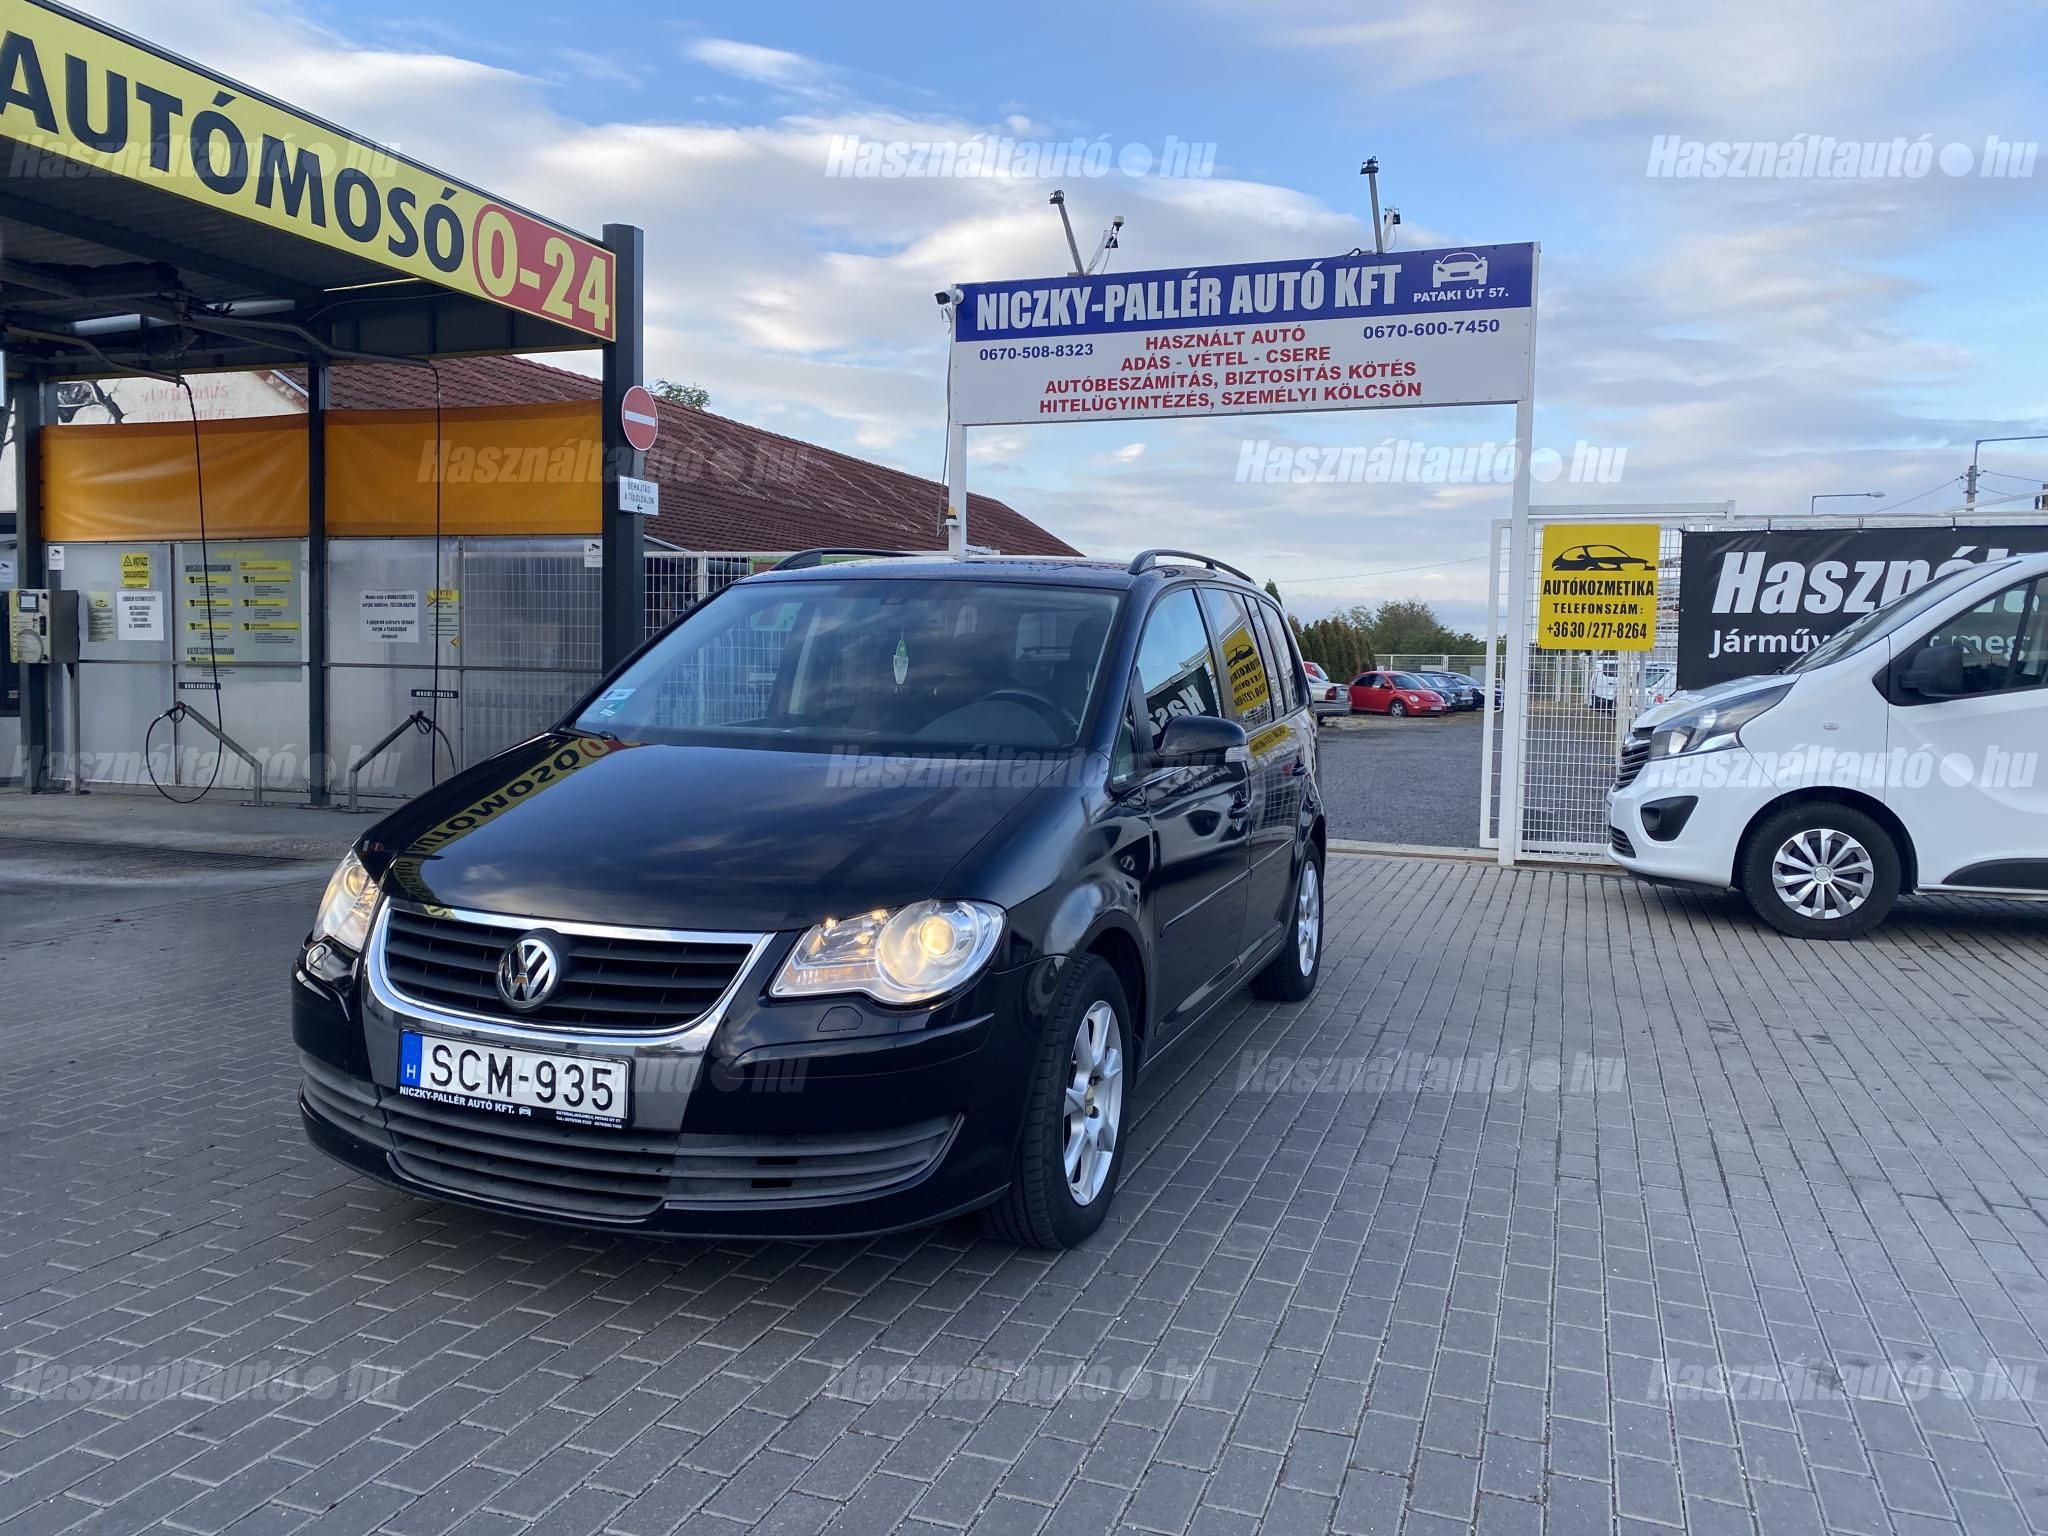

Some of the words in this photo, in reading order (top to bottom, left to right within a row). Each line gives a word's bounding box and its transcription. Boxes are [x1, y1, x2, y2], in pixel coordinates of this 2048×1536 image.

[0, 30, 465, 273] AUTÓMOSÓ
[477, 210, 610, 332] 0-24
[977, 271, 1222, 331] NICZKY-PALLÉR
[1229, 262, 1325, 315] AUTÓ
[1334, 264, 1402, 308] KFT
[1413, 290, 1461, 303] PATAKI
[1465, 287, 1485, 300] ÚT
[1488, 287, 1509, 298] 57.
[1145, 329, 1246, 351] HASZNÁLT
[1251, 324, 1306, 345] AUTÓ
[1363, 319, 1500, 339] 0670-600-7450
[979, 343, 1094, 361] 0670-508-8323
[1121, 354, 1171, 371] ADÁS
[1188, 348, 1248, 368] VÉTEL
[1266, 346, 1331, 363] CSERE
[1045, 371, 1218, 394] AUTÓBESZÁMÍTÁS,
[1225, 363, 1342, 386] BIZTOSÍTÁS
[1349, 359, 1417, 378] KÖTÉS
[1040, 391, 1215, 414] HITELÜGYINTÉZÉS,
[1221, 386, 1317, 406] SZEMÉLYI
[1324, 380, 1422, 401] KÖLCSÖN
[1543, 577, 1654, 596] AUTÓKOZMETIKA
[1553, 601, 1644, 615] TELEFONSZÁM:
[1709, 628, 1831, 659] Járműv
[406, 1064, 416, 1079] H
[430, 1044, 613, 1111] SCM-935
[400, 1086, 466, 1106] NICZKY-PALLÉR
[467, 1097, 493, 1111] AUTÓ
[495, 1102, 515, 1115] KFT.
